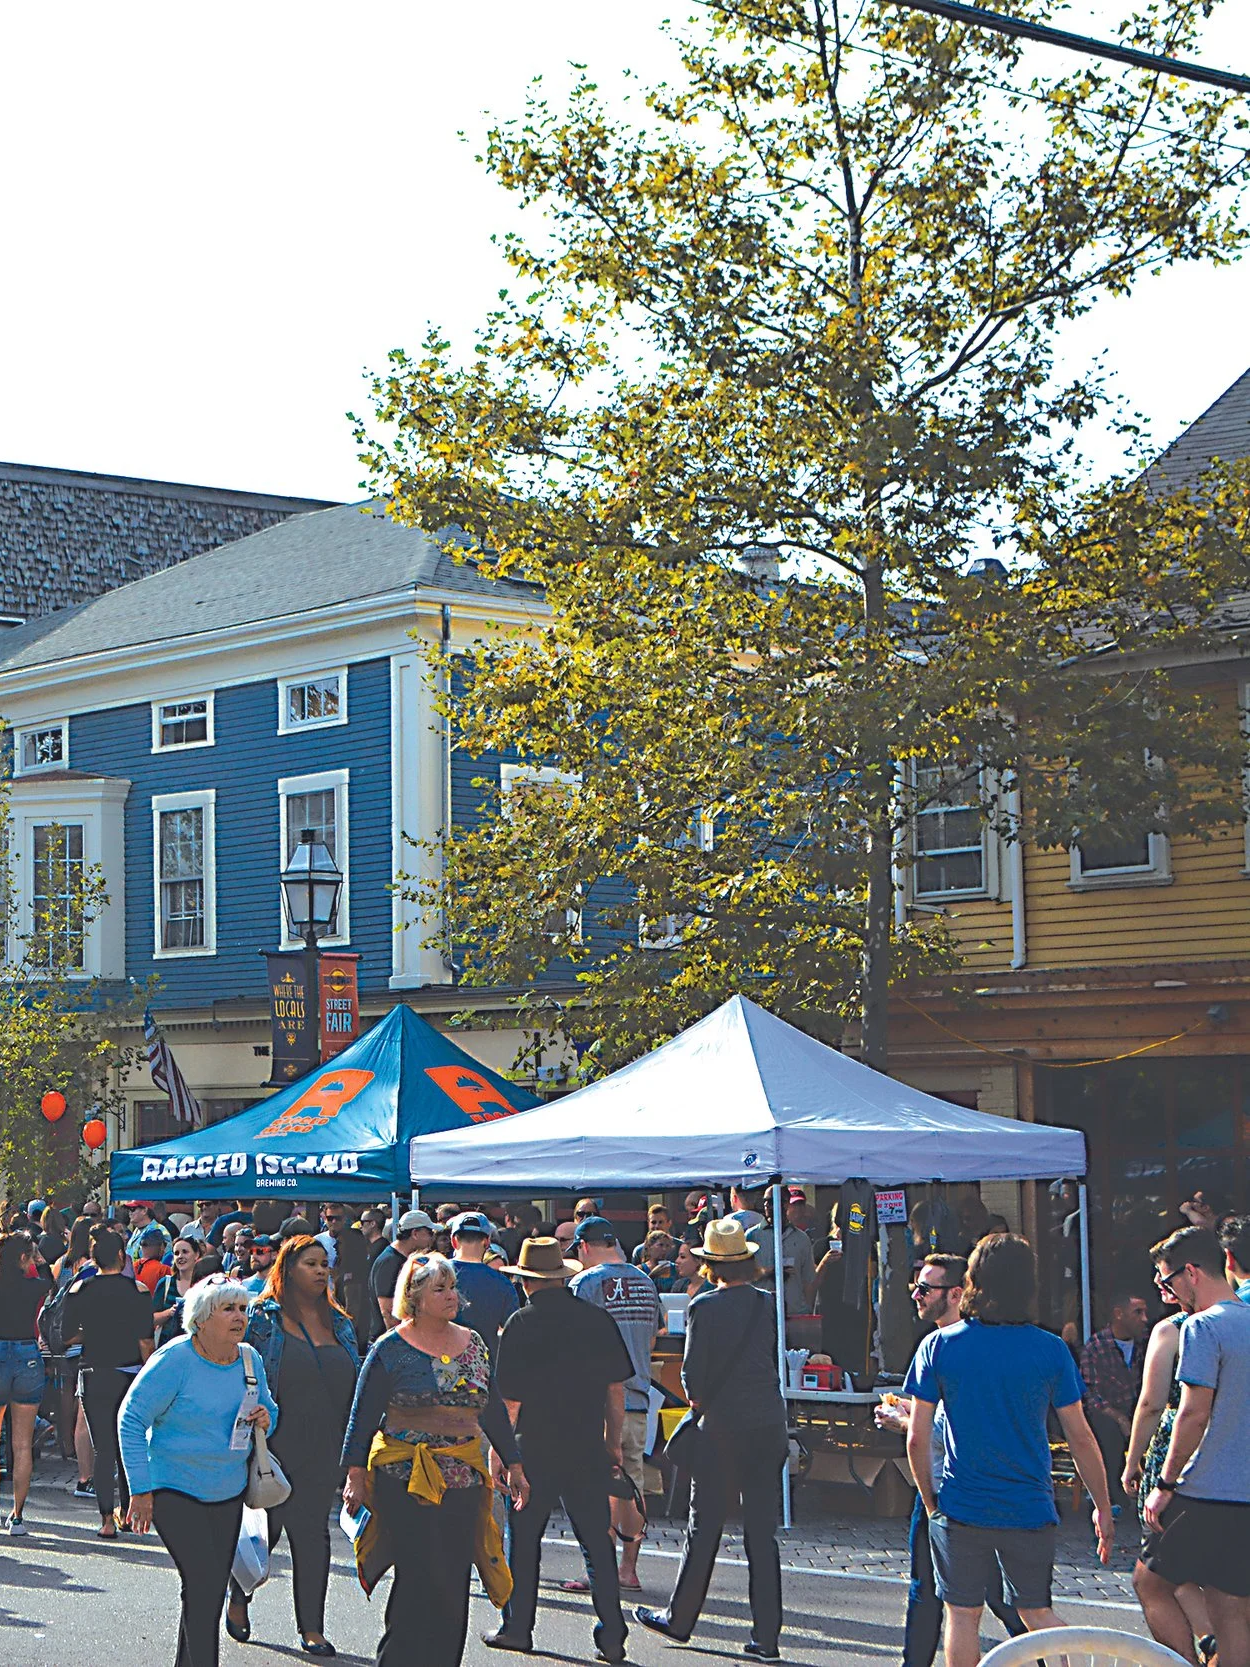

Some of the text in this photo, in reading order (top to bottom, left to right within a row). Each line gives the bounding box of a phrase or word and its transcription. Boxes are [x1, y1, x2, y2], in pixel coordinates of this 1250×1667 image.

[273, 985, 305, 999] WHERE THE
[275, 1000, 305, 1018] LOCALS
[325, 998, 352, 1010] STREET
[278, 1020, 305, 1030] ARE
[325, 1012, 352, 1032] FAIR
[253, 1046, 270, 1057] THE
[140, 1152, 360, 1182] RAGGED ISLAND
[256, 1178, 298, 1188] BREWING CO.
[875, 1192, 903, 1201] PARKING
[606, 1278, 626, 1301] A
